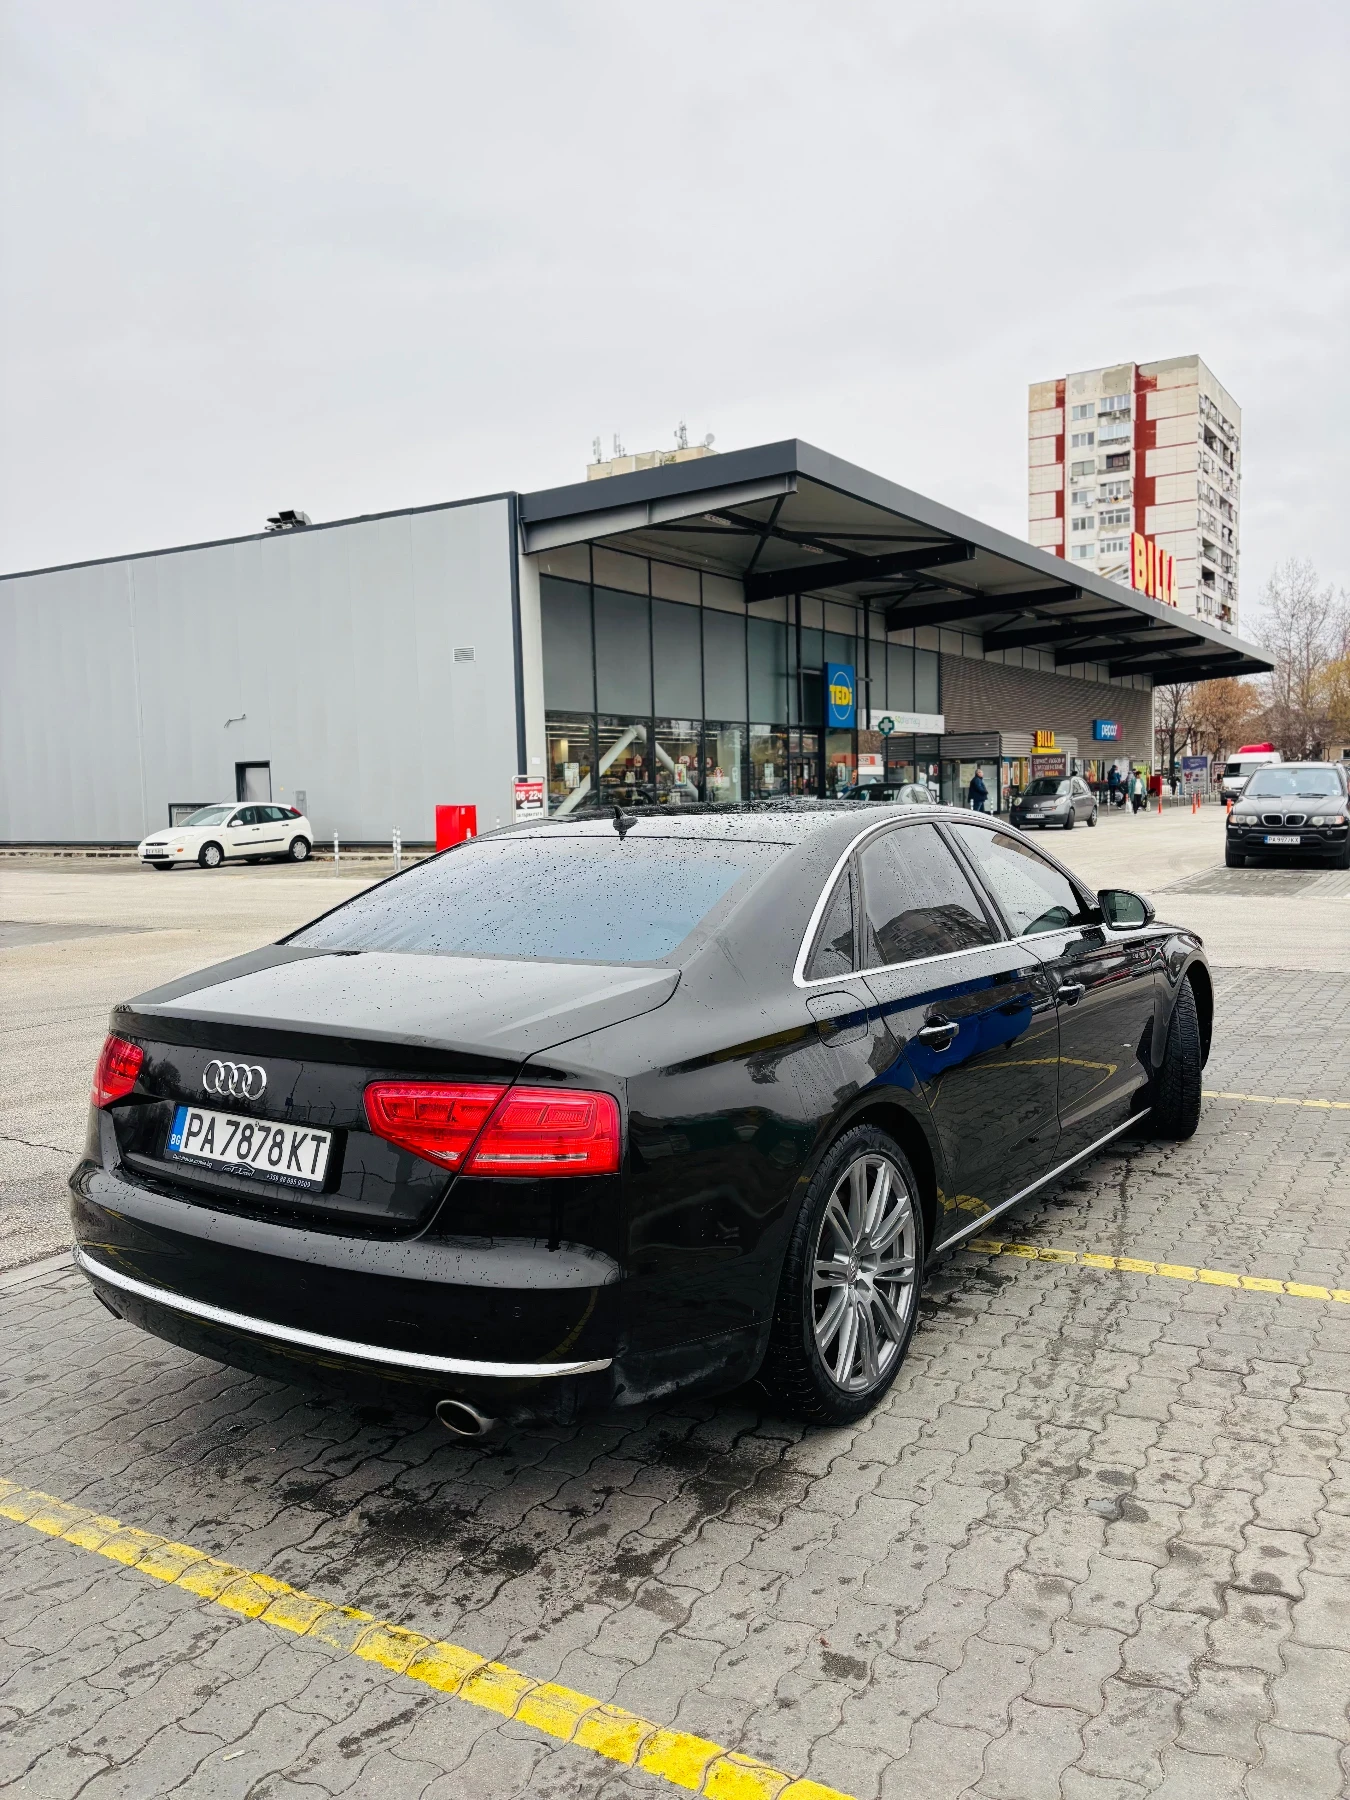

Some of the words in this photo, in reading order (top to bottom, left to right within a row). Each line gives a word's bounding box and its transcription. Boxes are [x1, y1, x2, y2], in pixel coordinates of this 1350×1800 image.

[1131, 532, 1179, 608] BILLA
[829, 684, 853, 706] TEDi
[1036, 730, 1055, 747] BILLA
[1101, 724, 1117, 738] pepco
[171, 1134, 181, 1145] BG
